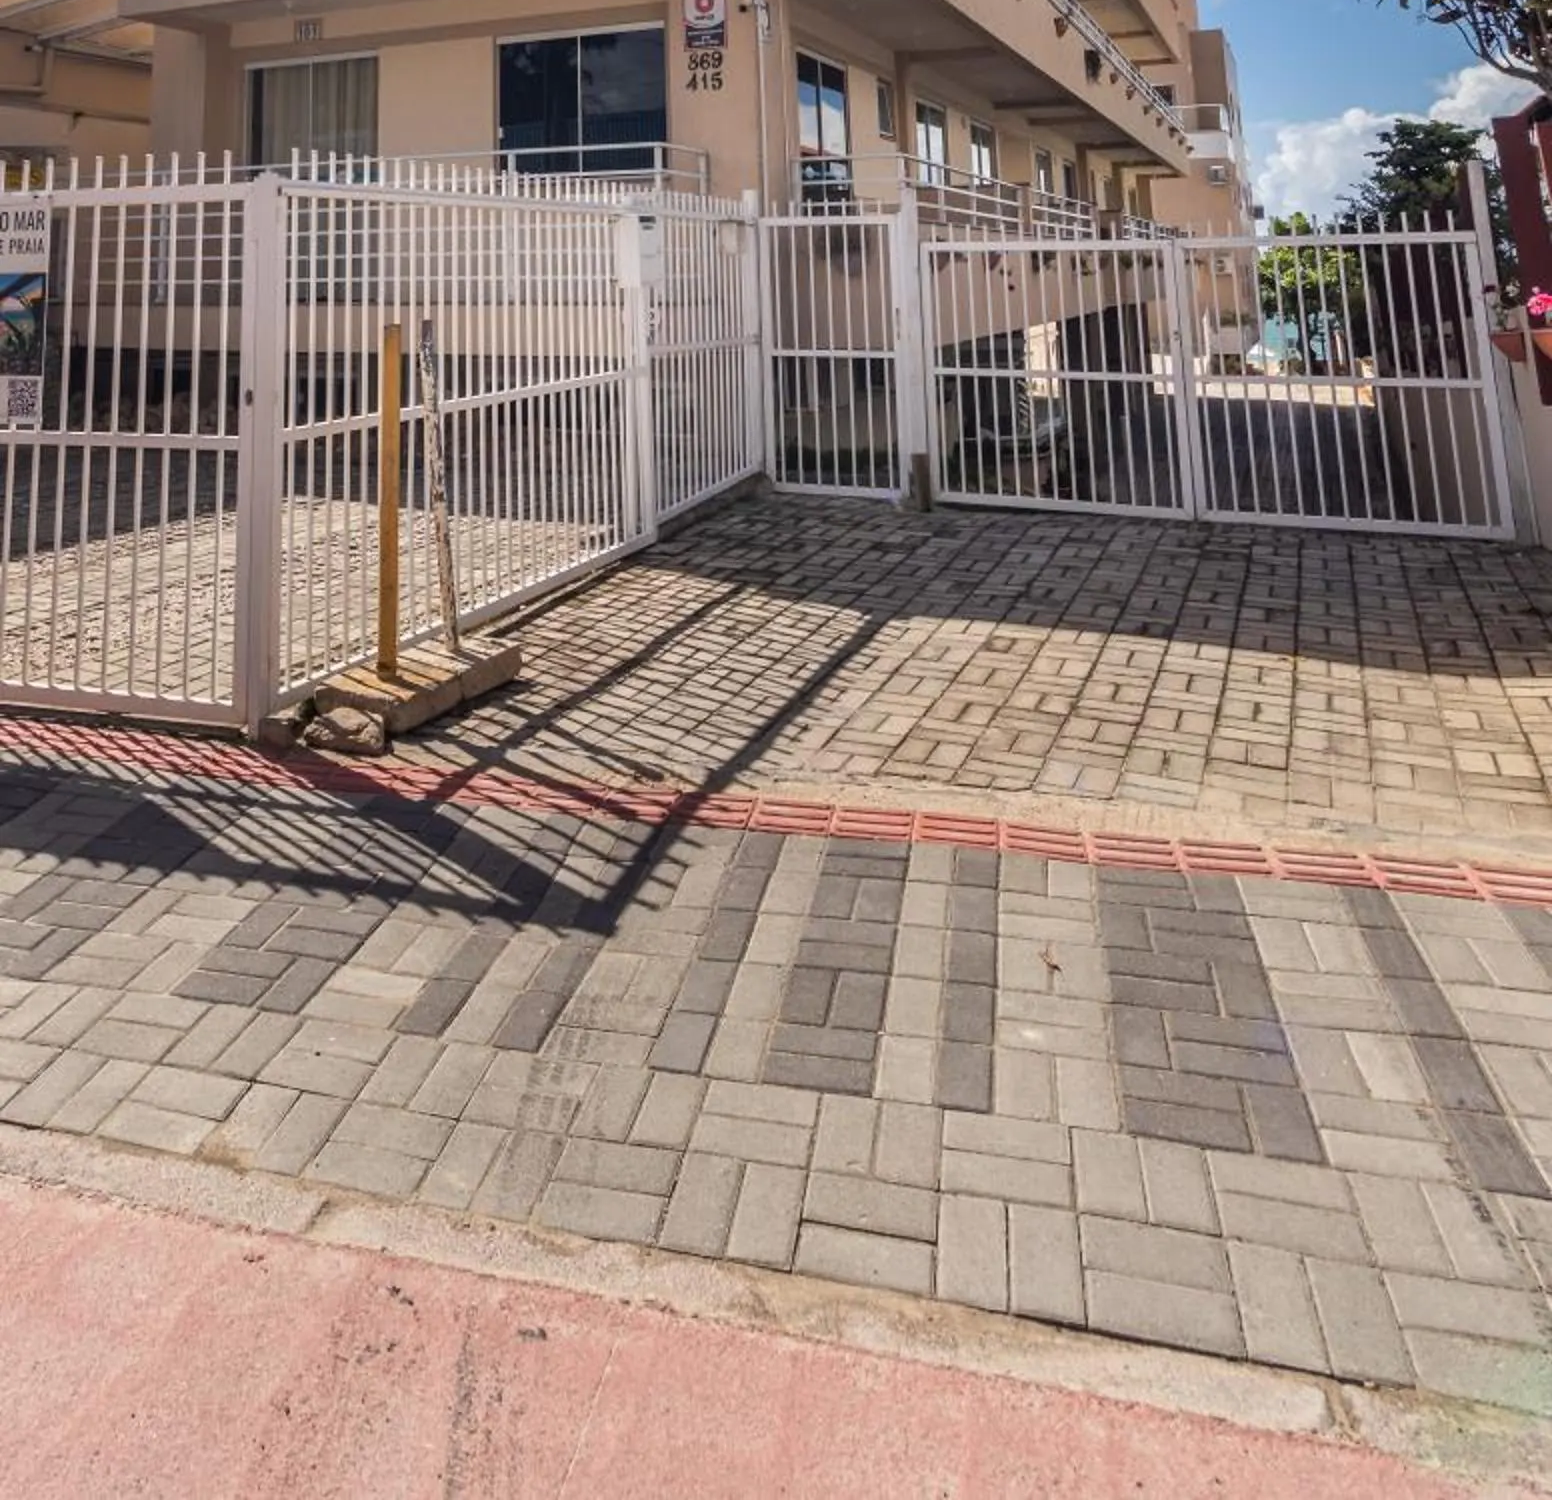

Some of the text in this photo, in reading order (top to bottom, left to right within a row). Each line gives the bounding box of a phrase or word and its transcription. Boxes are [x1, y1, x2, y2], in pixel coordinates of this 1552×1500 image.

[687, 51, 723, 71] 869
[686, 72, 723, 91] 415
[13, 210, 45, 231] MAR
[9, 238, 45, 255] PRAIA
